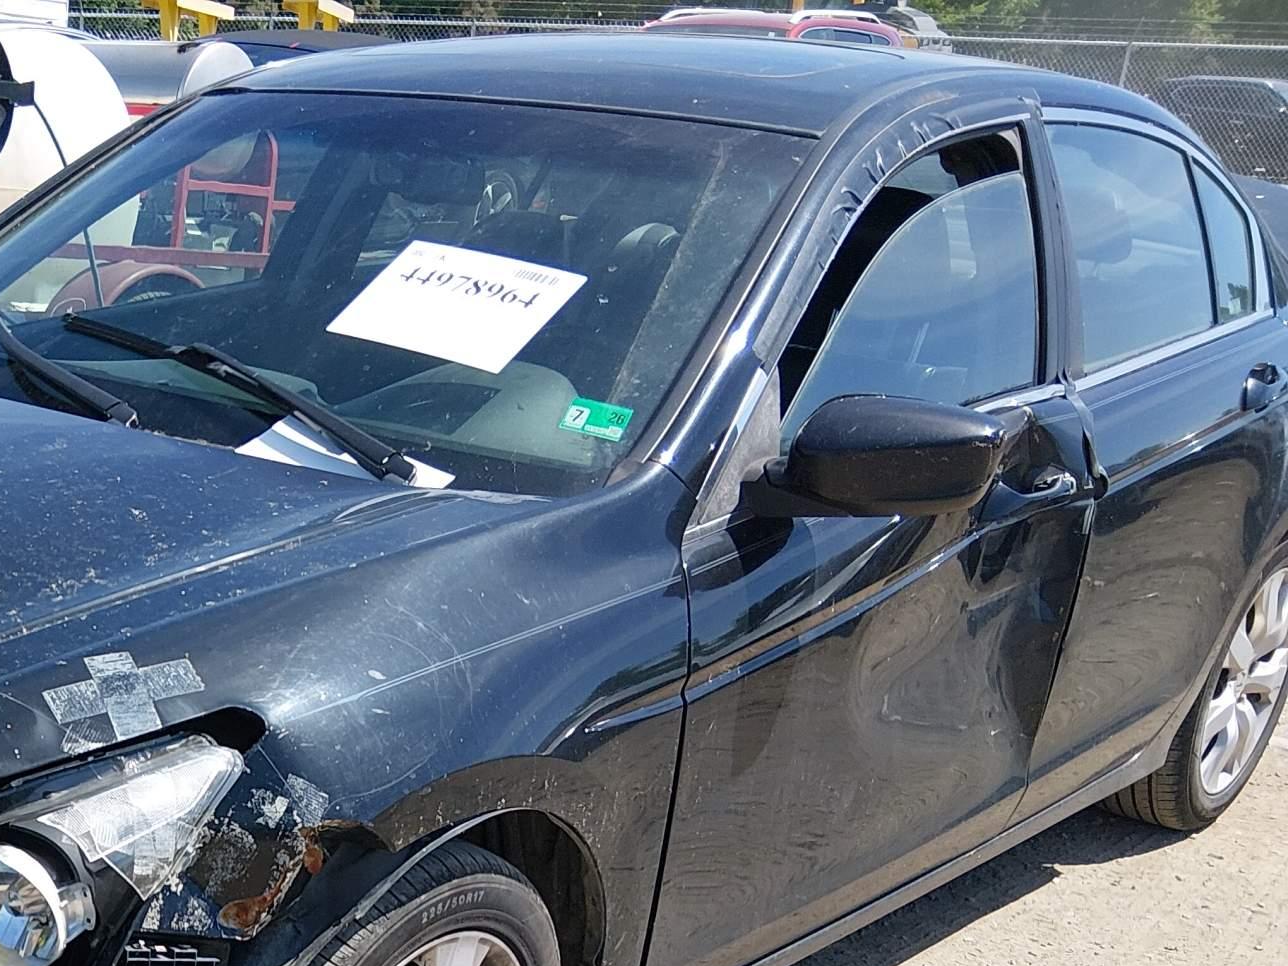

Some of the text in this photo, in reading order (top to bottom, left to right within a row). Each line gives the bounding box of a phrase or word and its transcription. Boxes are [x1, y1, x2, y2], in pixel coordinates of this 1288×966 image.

[400, 267, 540, 308] 44978964
[573, 409, 626, 425] 7 26
[421, 890, 485, 924] 225/50R17
